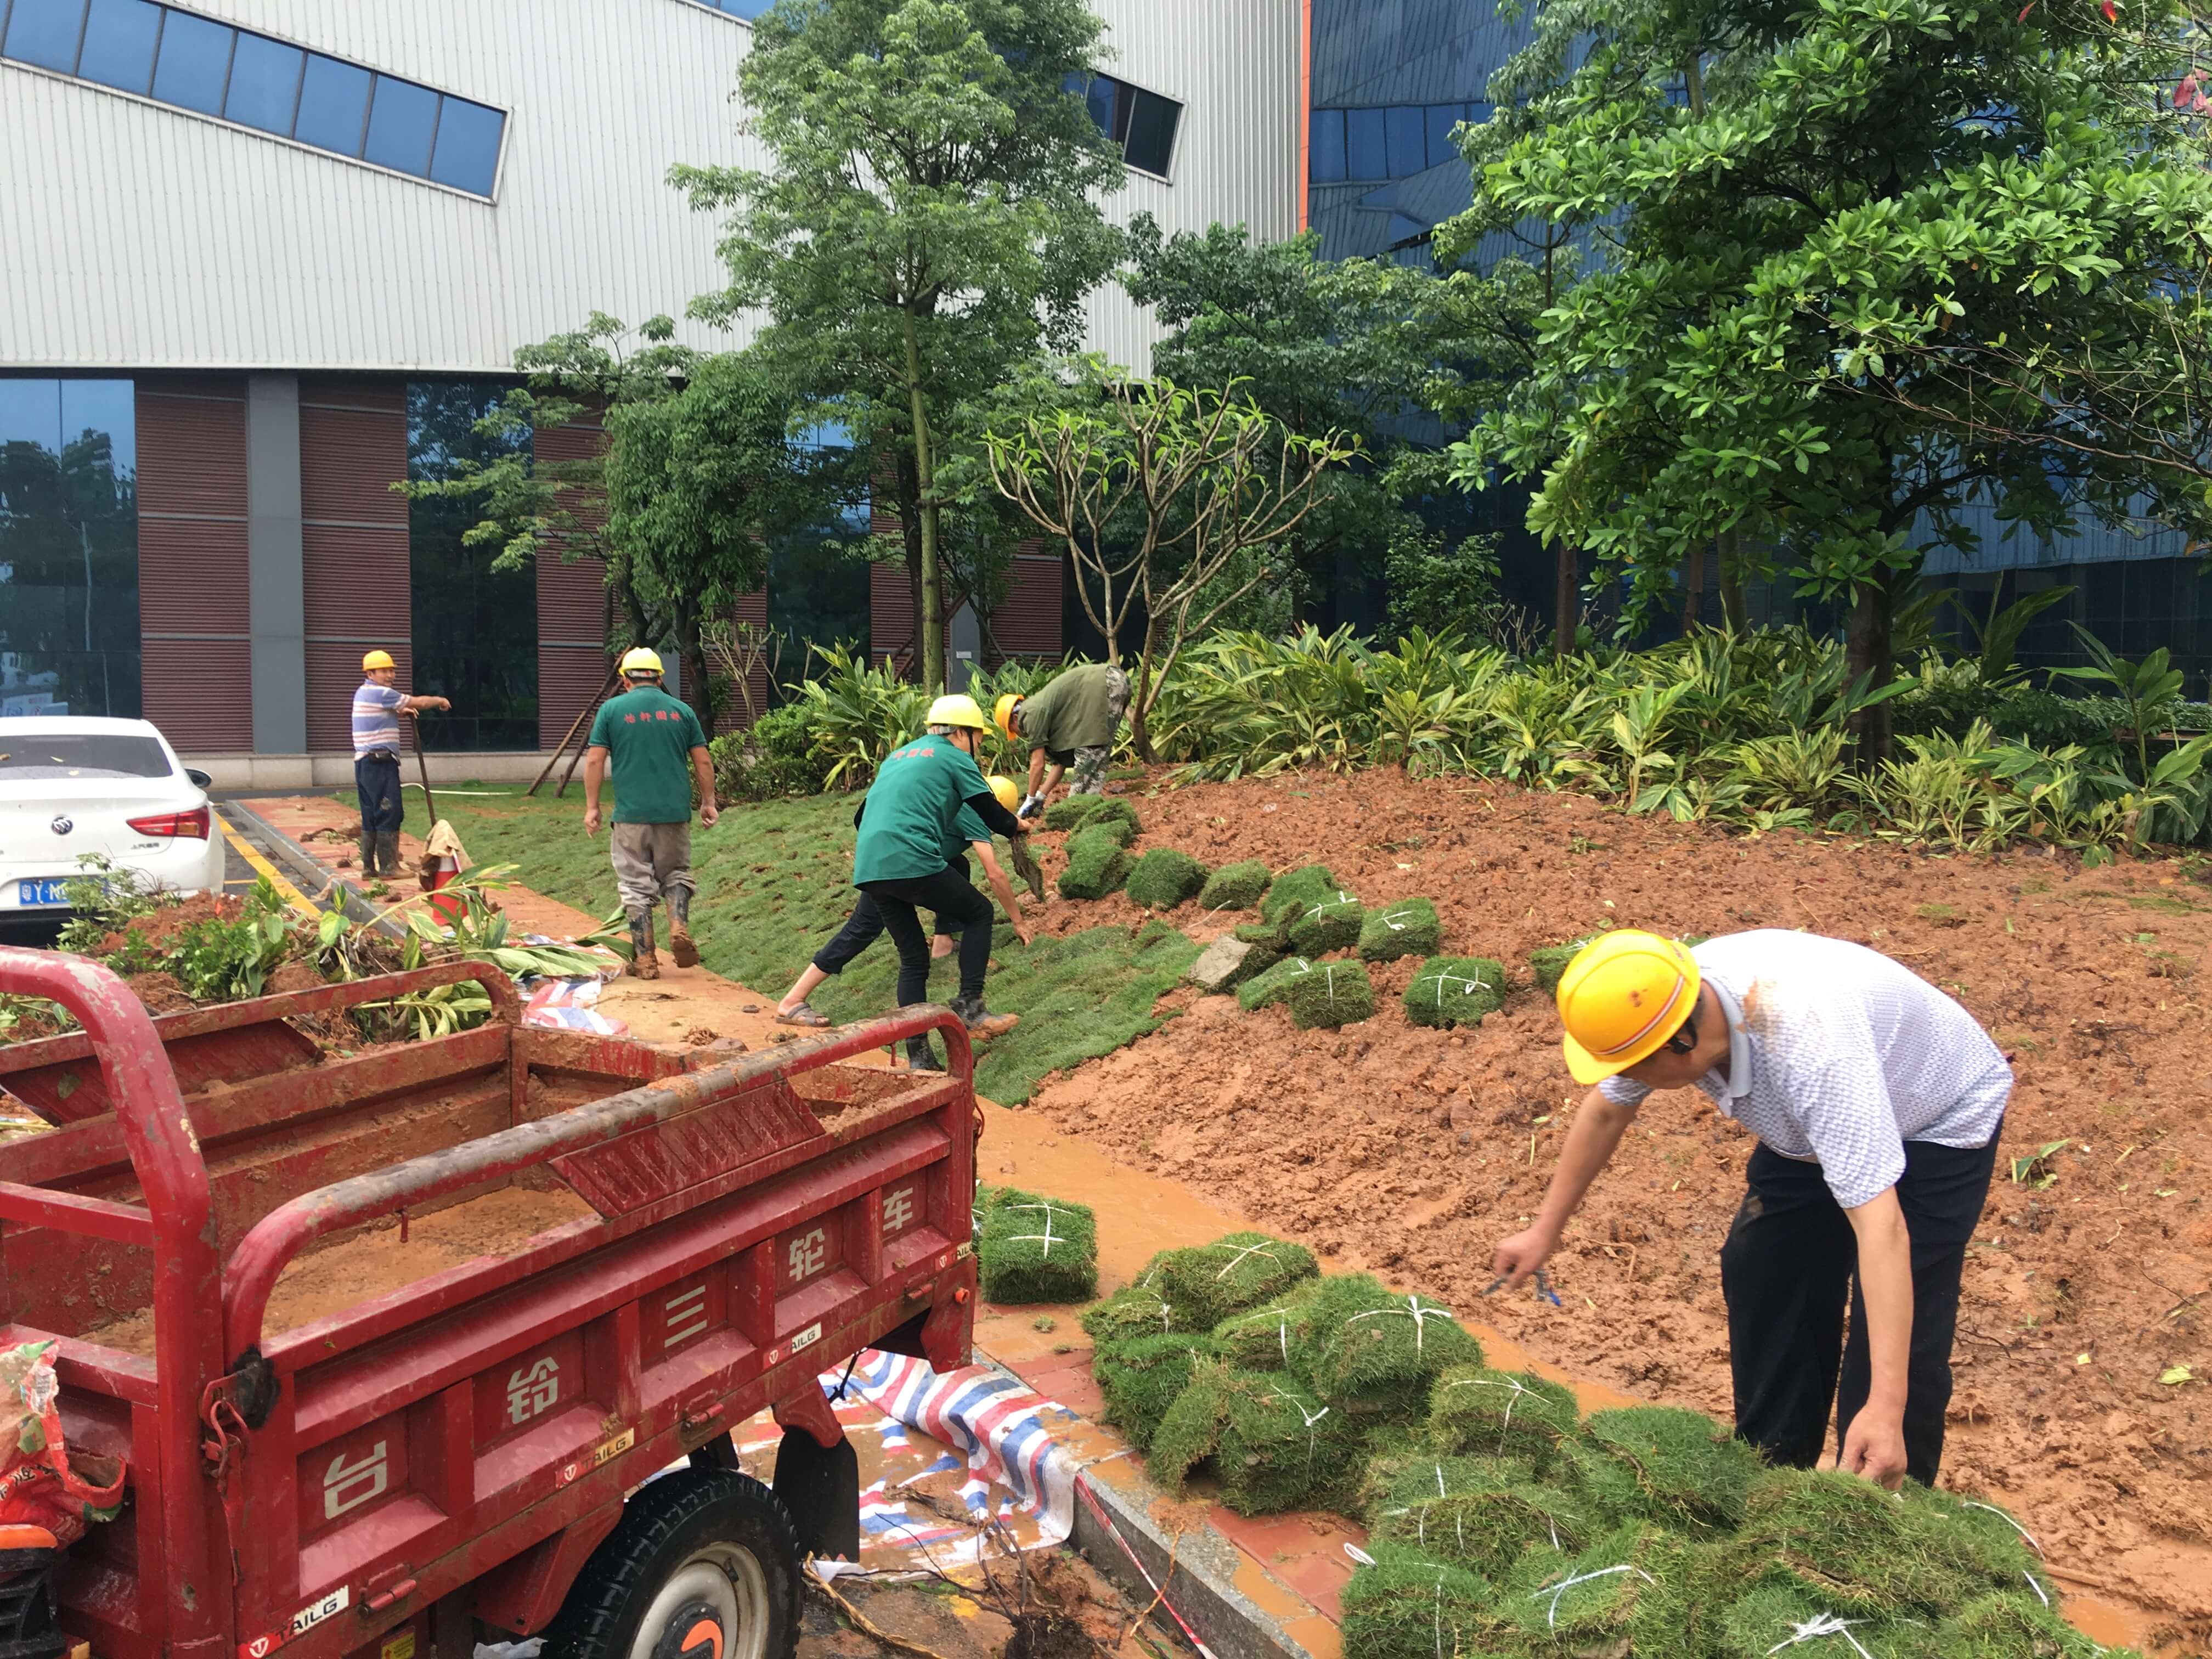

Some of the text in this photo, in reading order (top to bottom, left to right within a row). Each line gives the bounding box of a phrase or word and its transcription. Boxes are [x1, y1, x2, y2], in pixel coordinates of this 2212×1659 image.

[781, 1330, 816, 1354] TAILG
[582, 1437, 627, 1469] TAILG
[275, 1598, 337, 1640] TAILG
